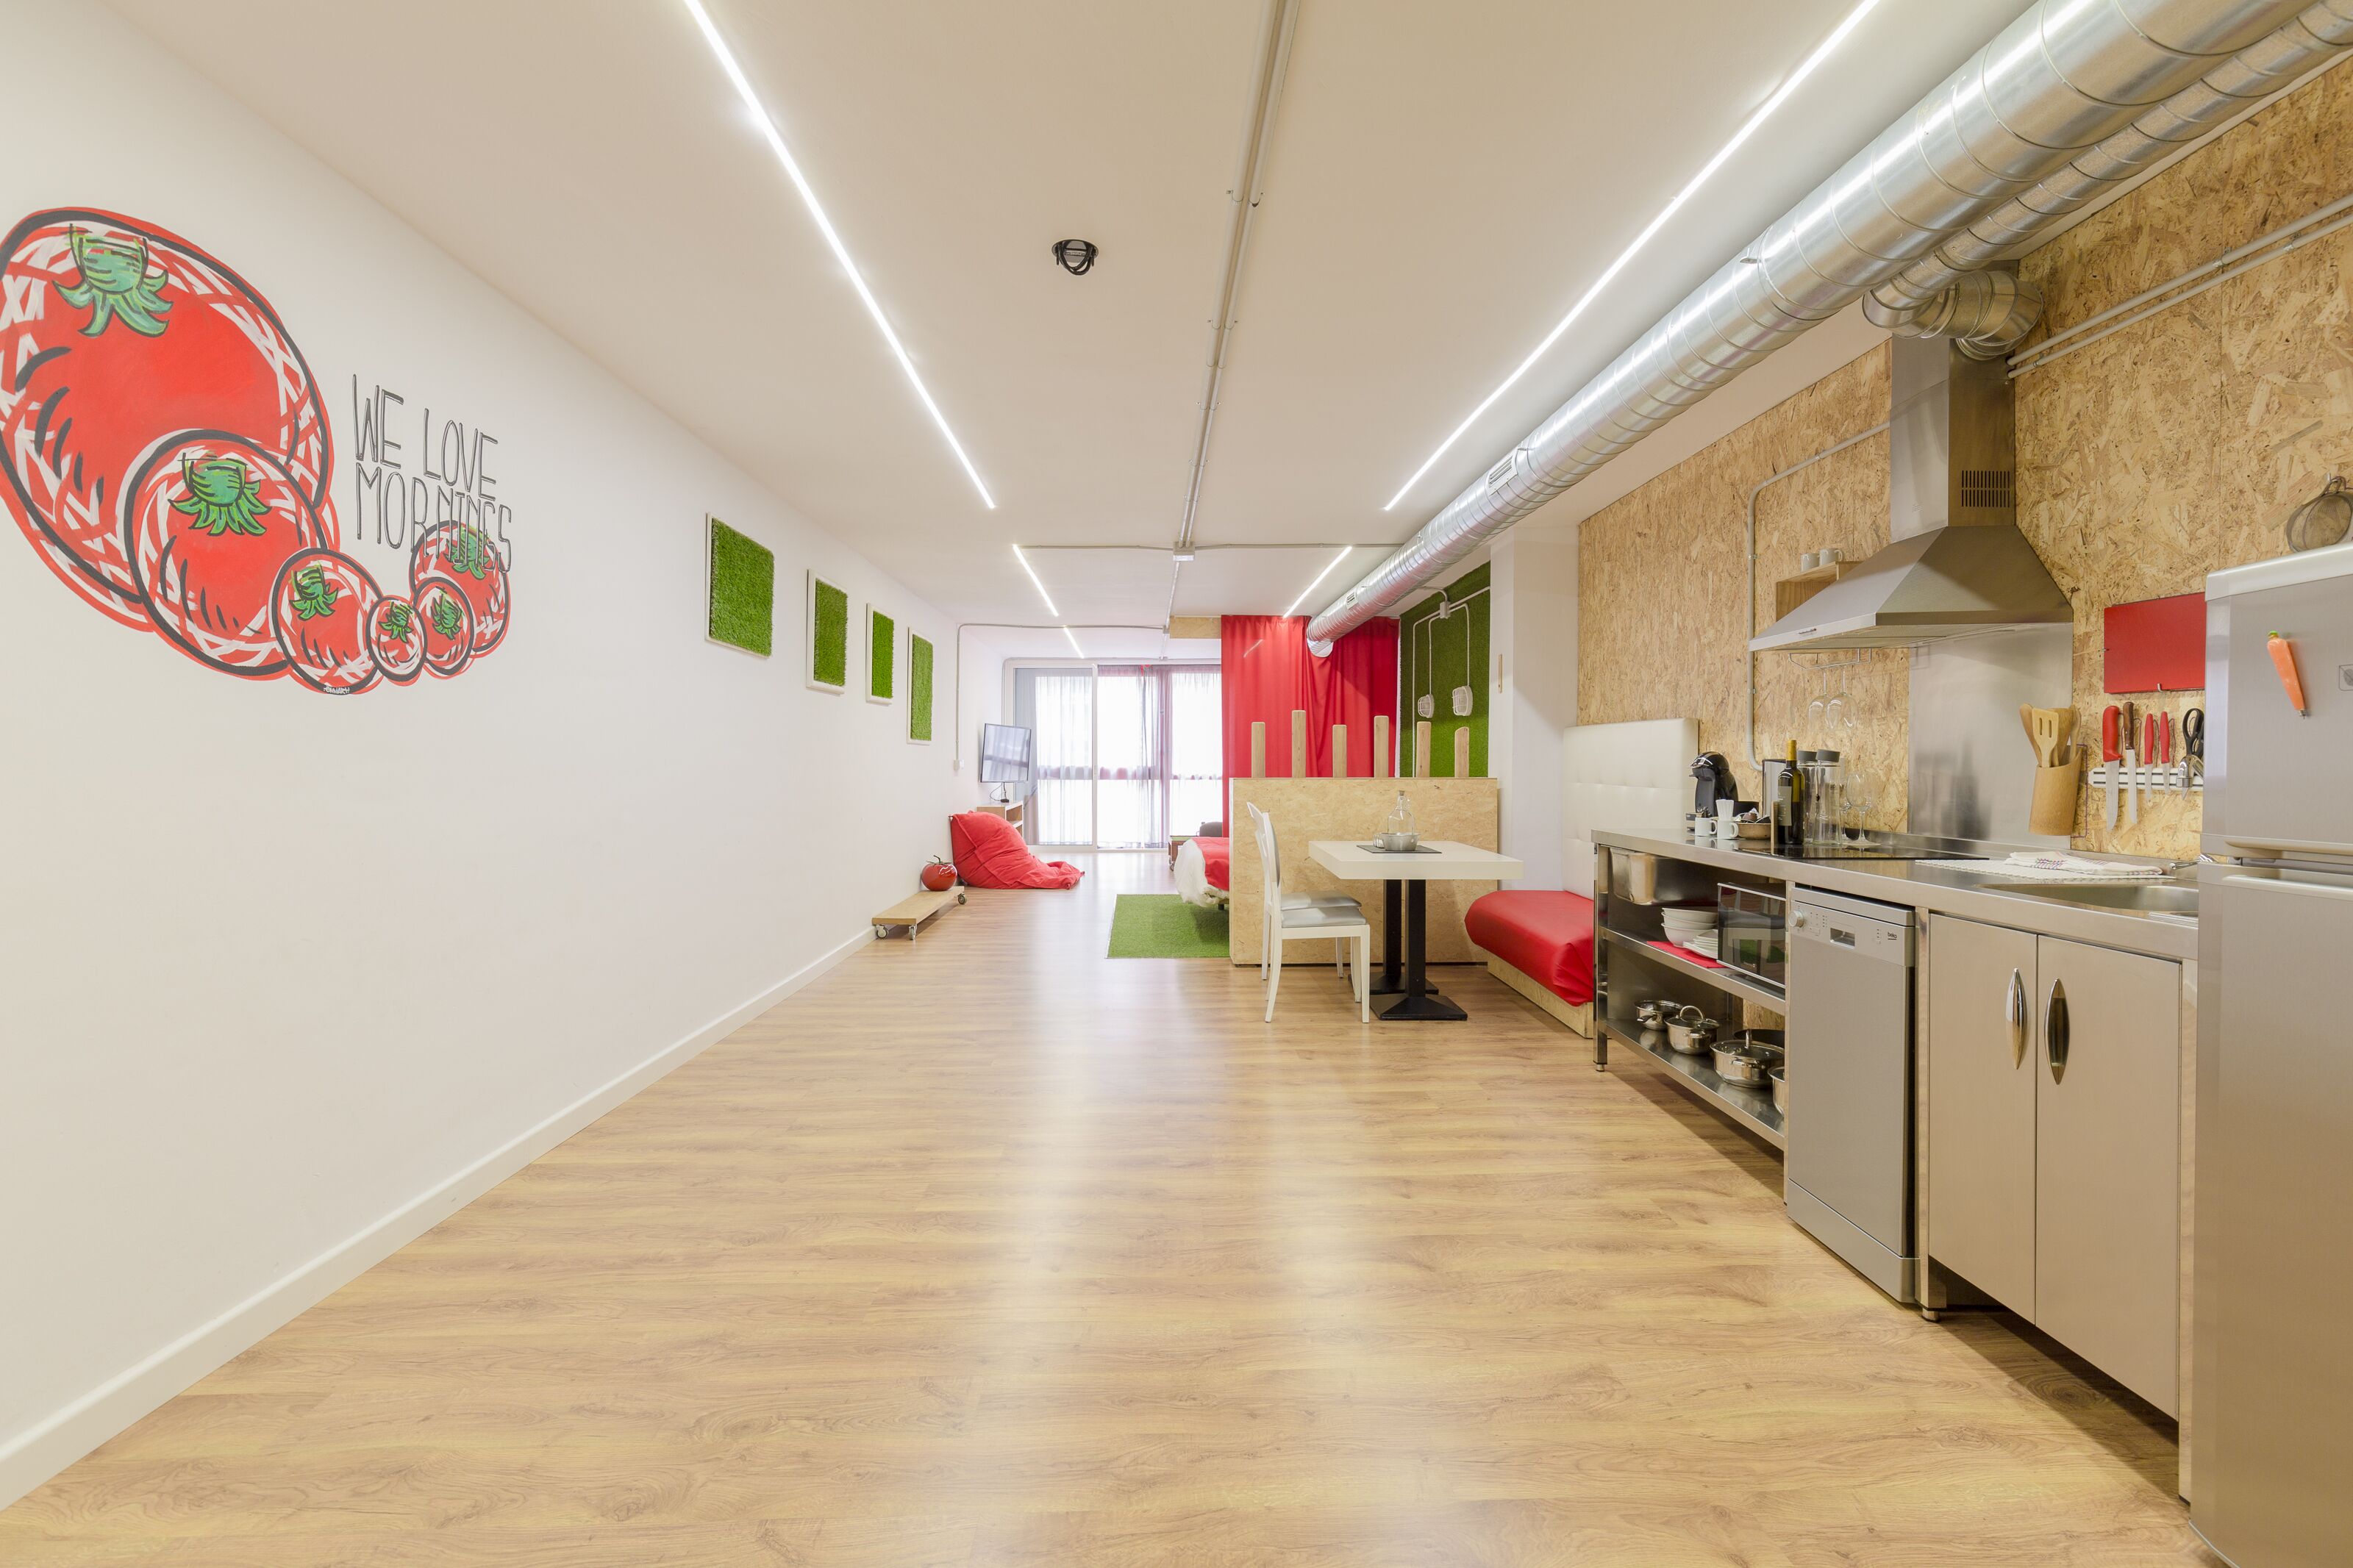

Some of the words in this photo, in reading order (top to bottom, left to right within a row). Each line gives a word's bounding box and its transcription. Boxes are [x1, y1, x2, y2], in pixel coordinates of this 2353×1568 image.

[353, 373, 404, 468] WE
[424, 408, 498, 501] LOVE
[356, 462, 511, 573] MORNINGS
